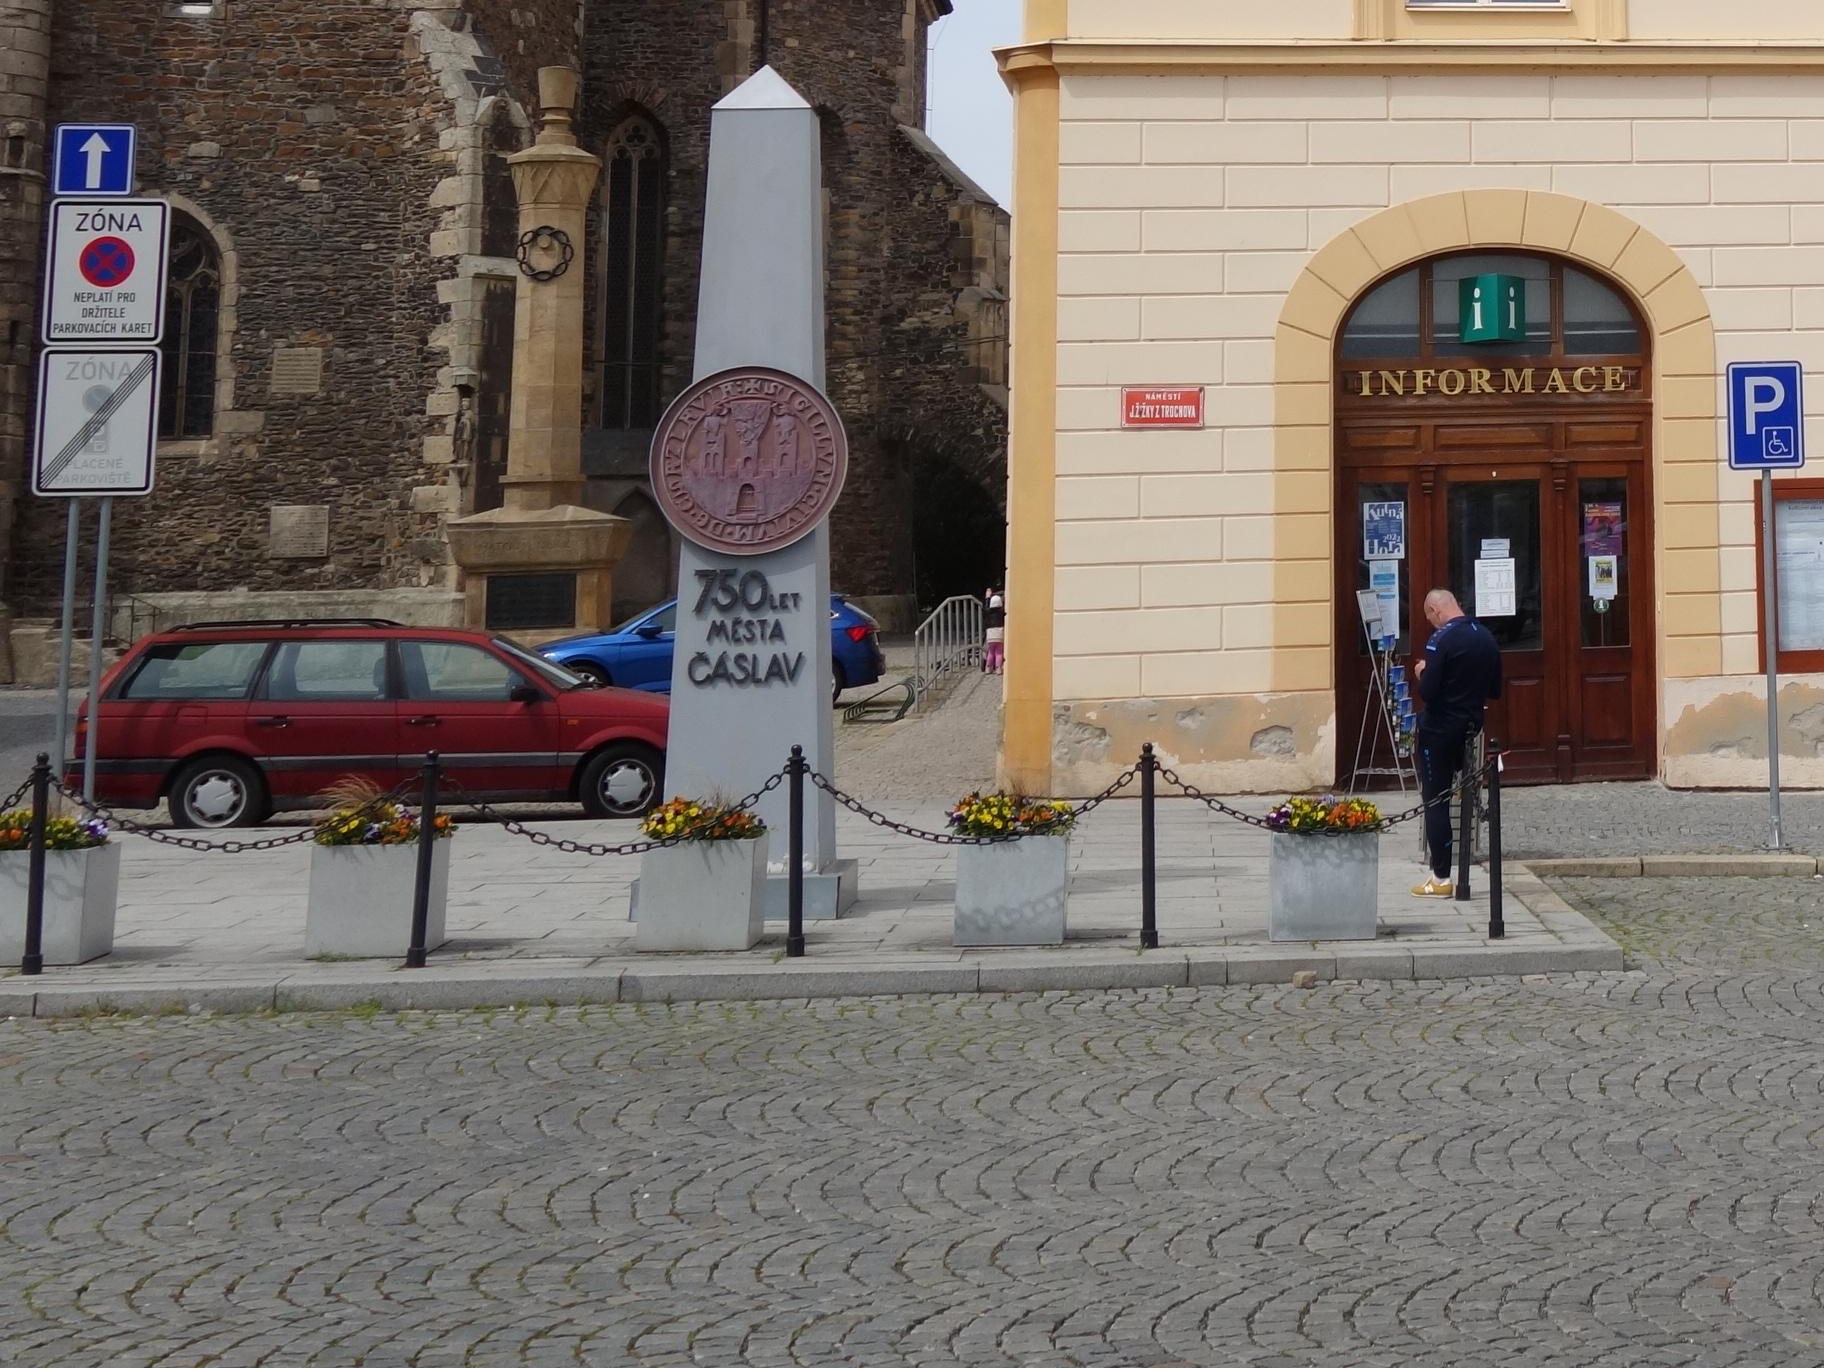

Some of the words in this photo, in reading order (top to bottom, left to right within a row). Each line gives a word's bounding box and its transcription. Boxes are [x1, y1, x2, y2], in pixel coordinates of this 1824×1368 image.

[75, 208, 142, 232] ZÓNA
[74, 290, 113, 303] NEPLATÍ
[117, 292, 136, 303] PRO
[82, 305, 125, 319] DRŽITELE
[53, 320, 116, 334] PARKOVACÍCH
[121, 323, 152, 333] KARET
[65, 356, 132, 380] ZÓNA
[1358, 366, 1626, 396] INFORMACE
[1145, 392, 1181, 400] NÁMĚSTÍ
[1744, 376, 1785, 435] P
[692, 568, 768, 614] 750
[768, 592, 801, 610] LET
[706, 617, 786, 643] MĚSTA
[687, 651, 803, 685] ČÁSLAV
